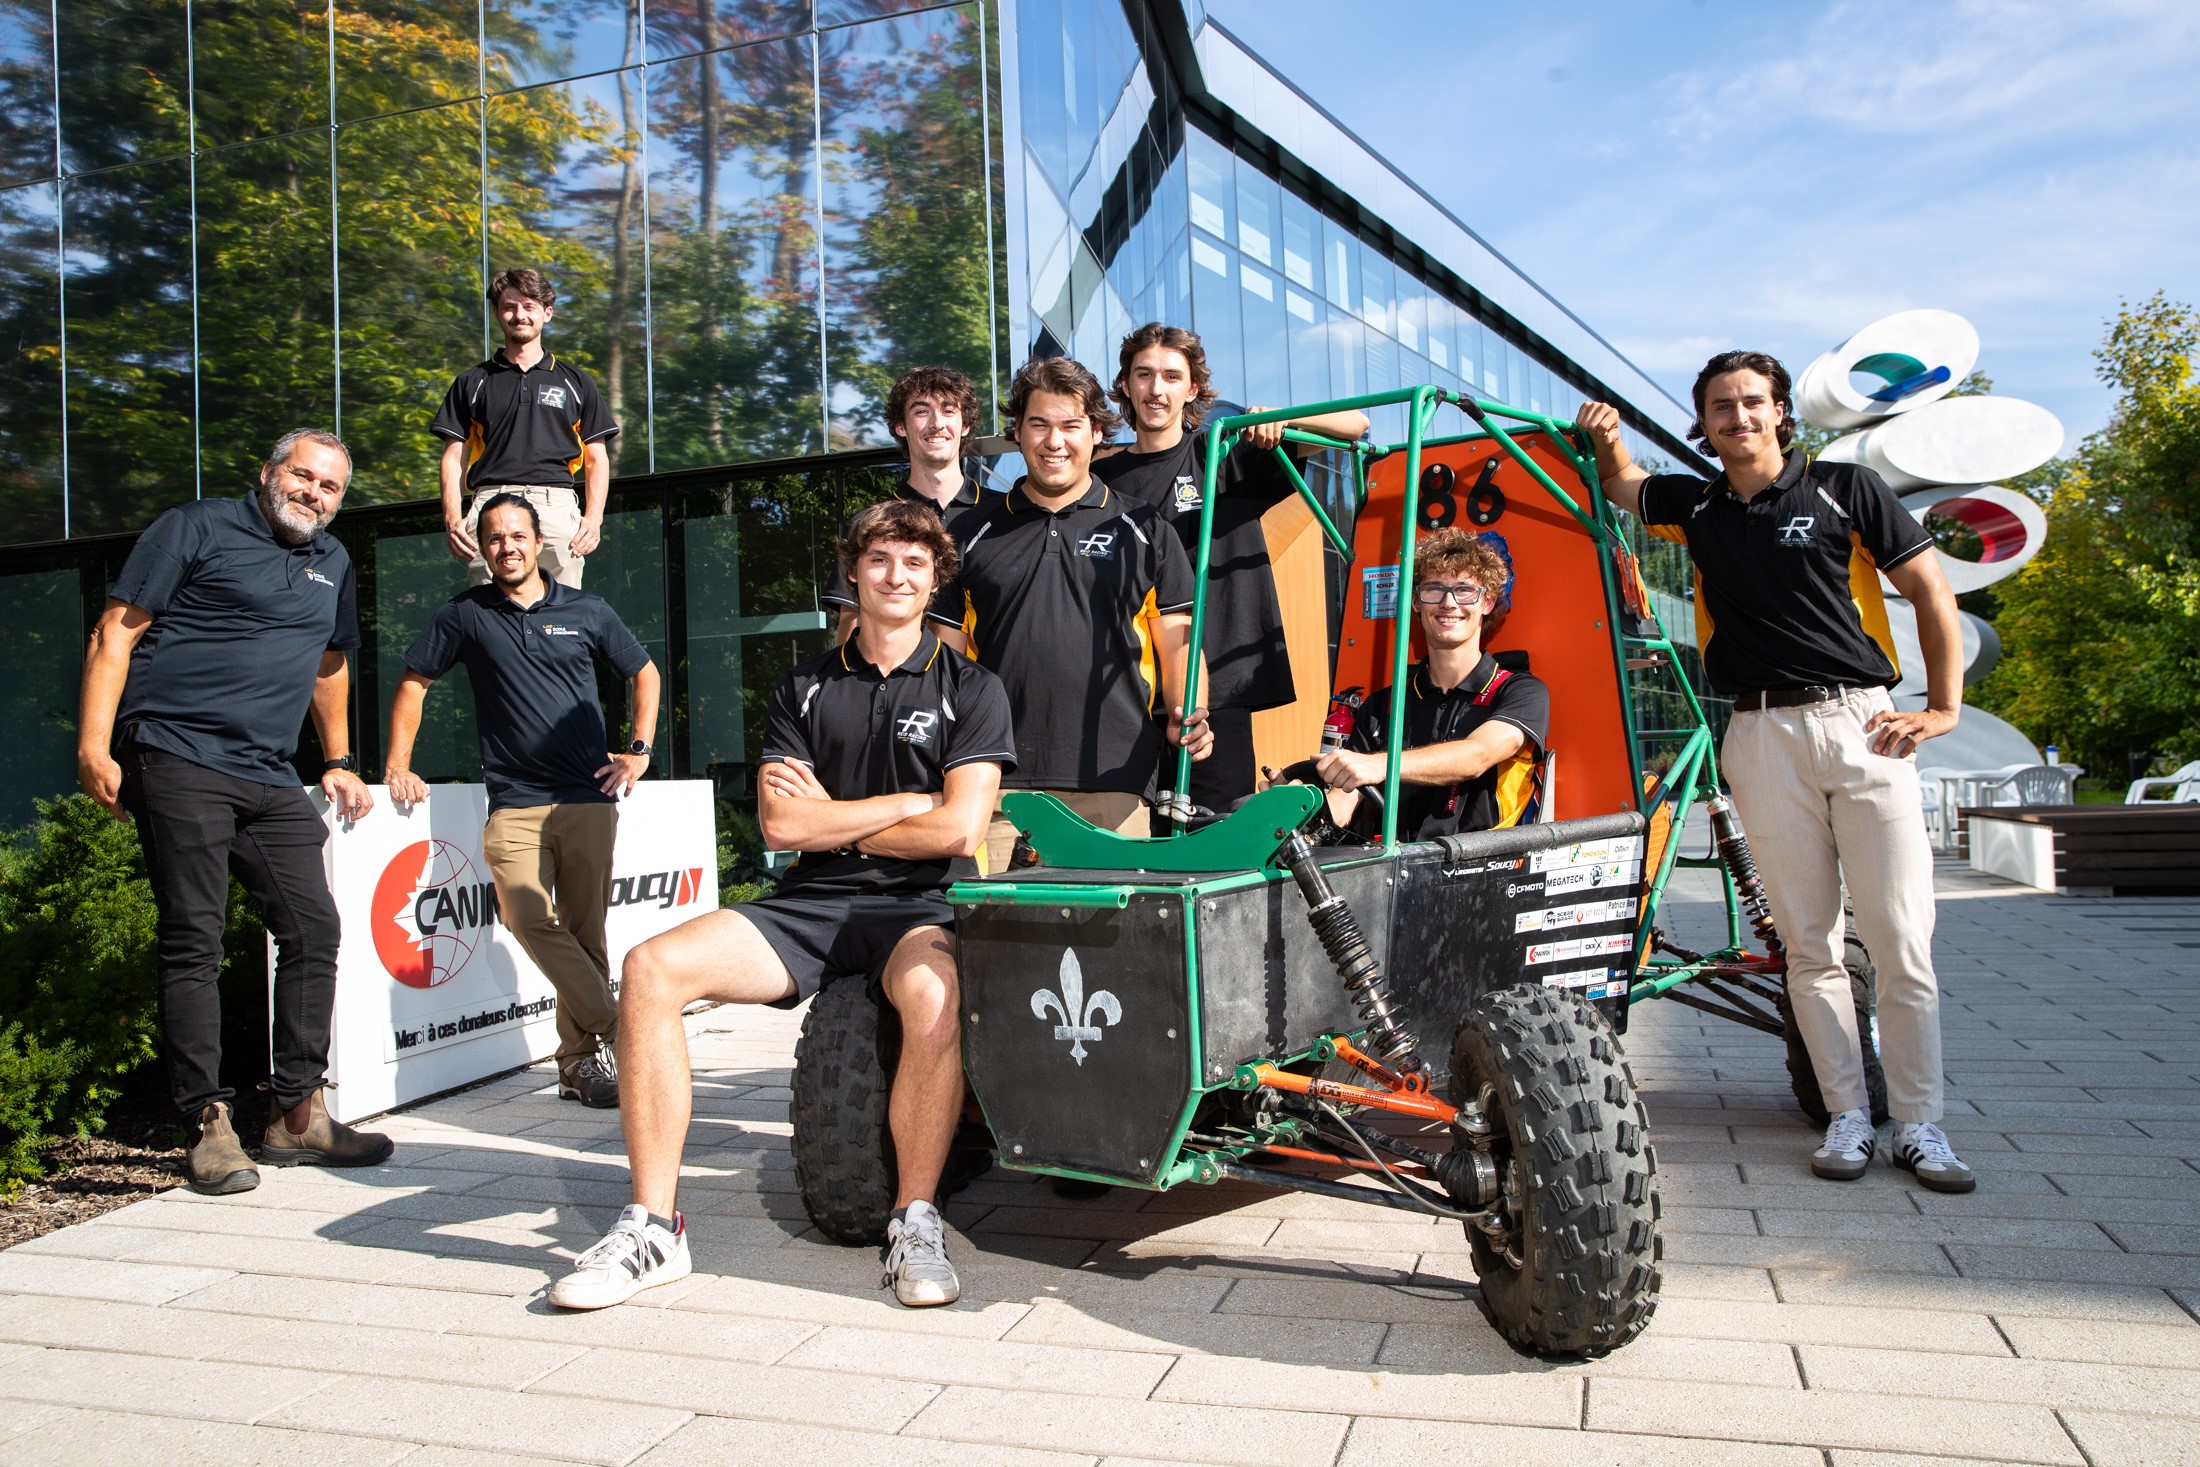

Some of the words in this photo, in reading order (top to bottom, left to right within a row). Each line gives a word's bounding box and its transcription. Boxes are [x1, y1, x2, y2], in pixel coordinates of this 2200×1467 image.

[1417, 457, 1505, 531] 86
[608, 871, 680, 909] oucy
[1516, 883, 1544, 893] CFMOTO
[1546, 874, 1584, 888] MEGATECH
[1608, 902, 1625, 910] Patrice
[1626, 899, 1636, 908] Roy
[395, 1025, 425, 1051] Merci
[428, 1022, 437, 1042] à
[437, 1021, 457, 1040] ces
[458, 1008, 507, 1034] donateurs
